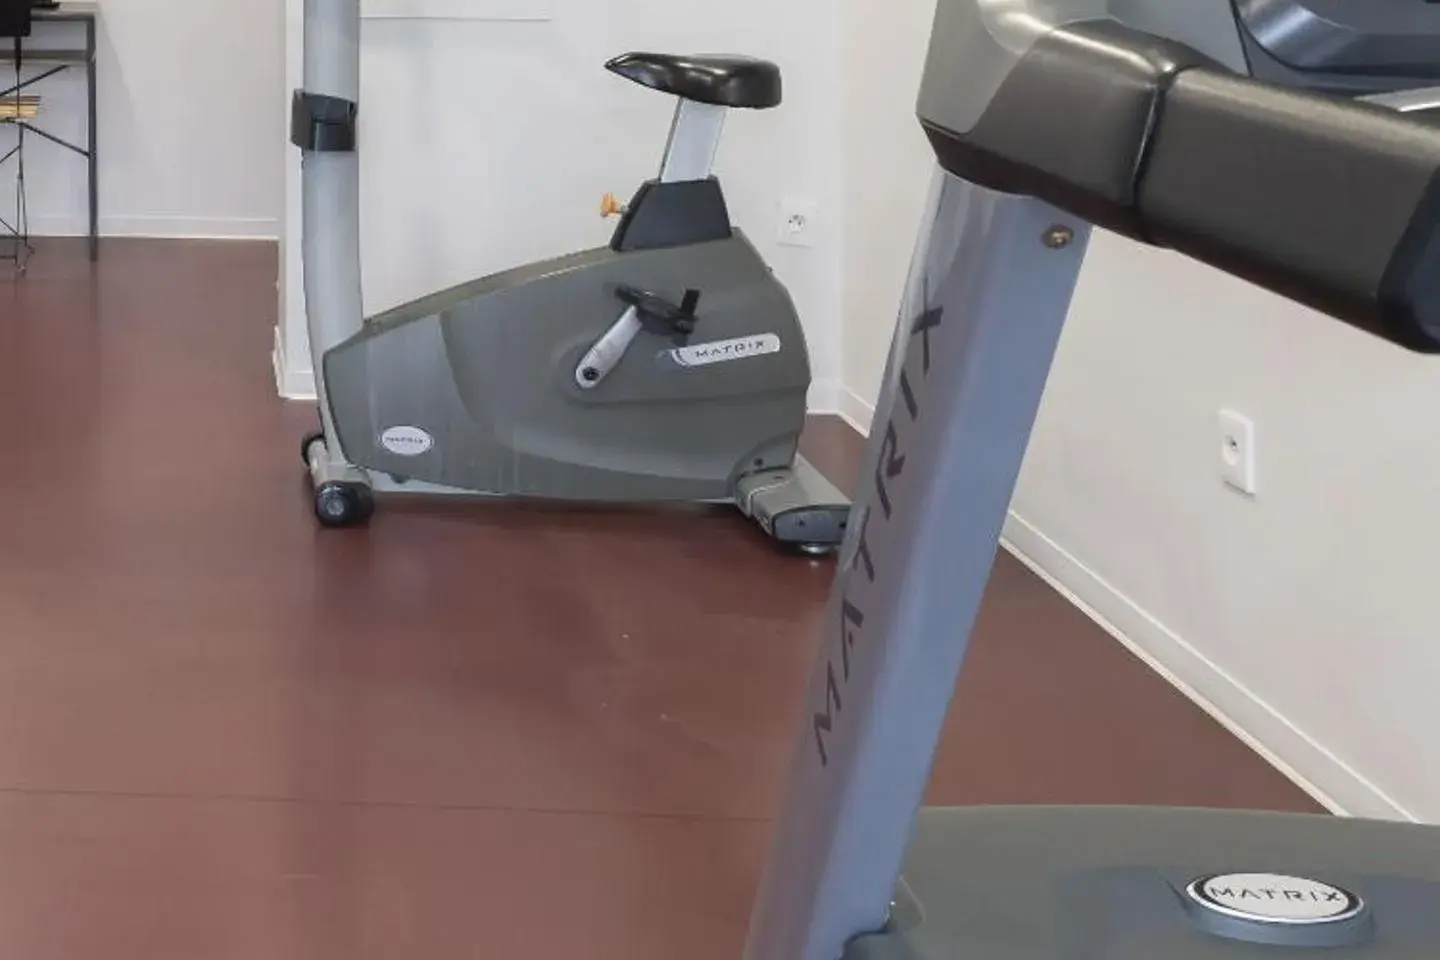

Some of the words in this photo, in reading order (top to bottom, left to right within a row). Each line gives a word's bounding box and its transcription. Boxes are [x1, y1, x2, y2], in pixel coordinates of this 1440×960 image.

[695, 340, 764, 358] MATRIX
[810, 275, 944, 767] MATRIX
[1210, 886, 1343, 903] MATRIX
